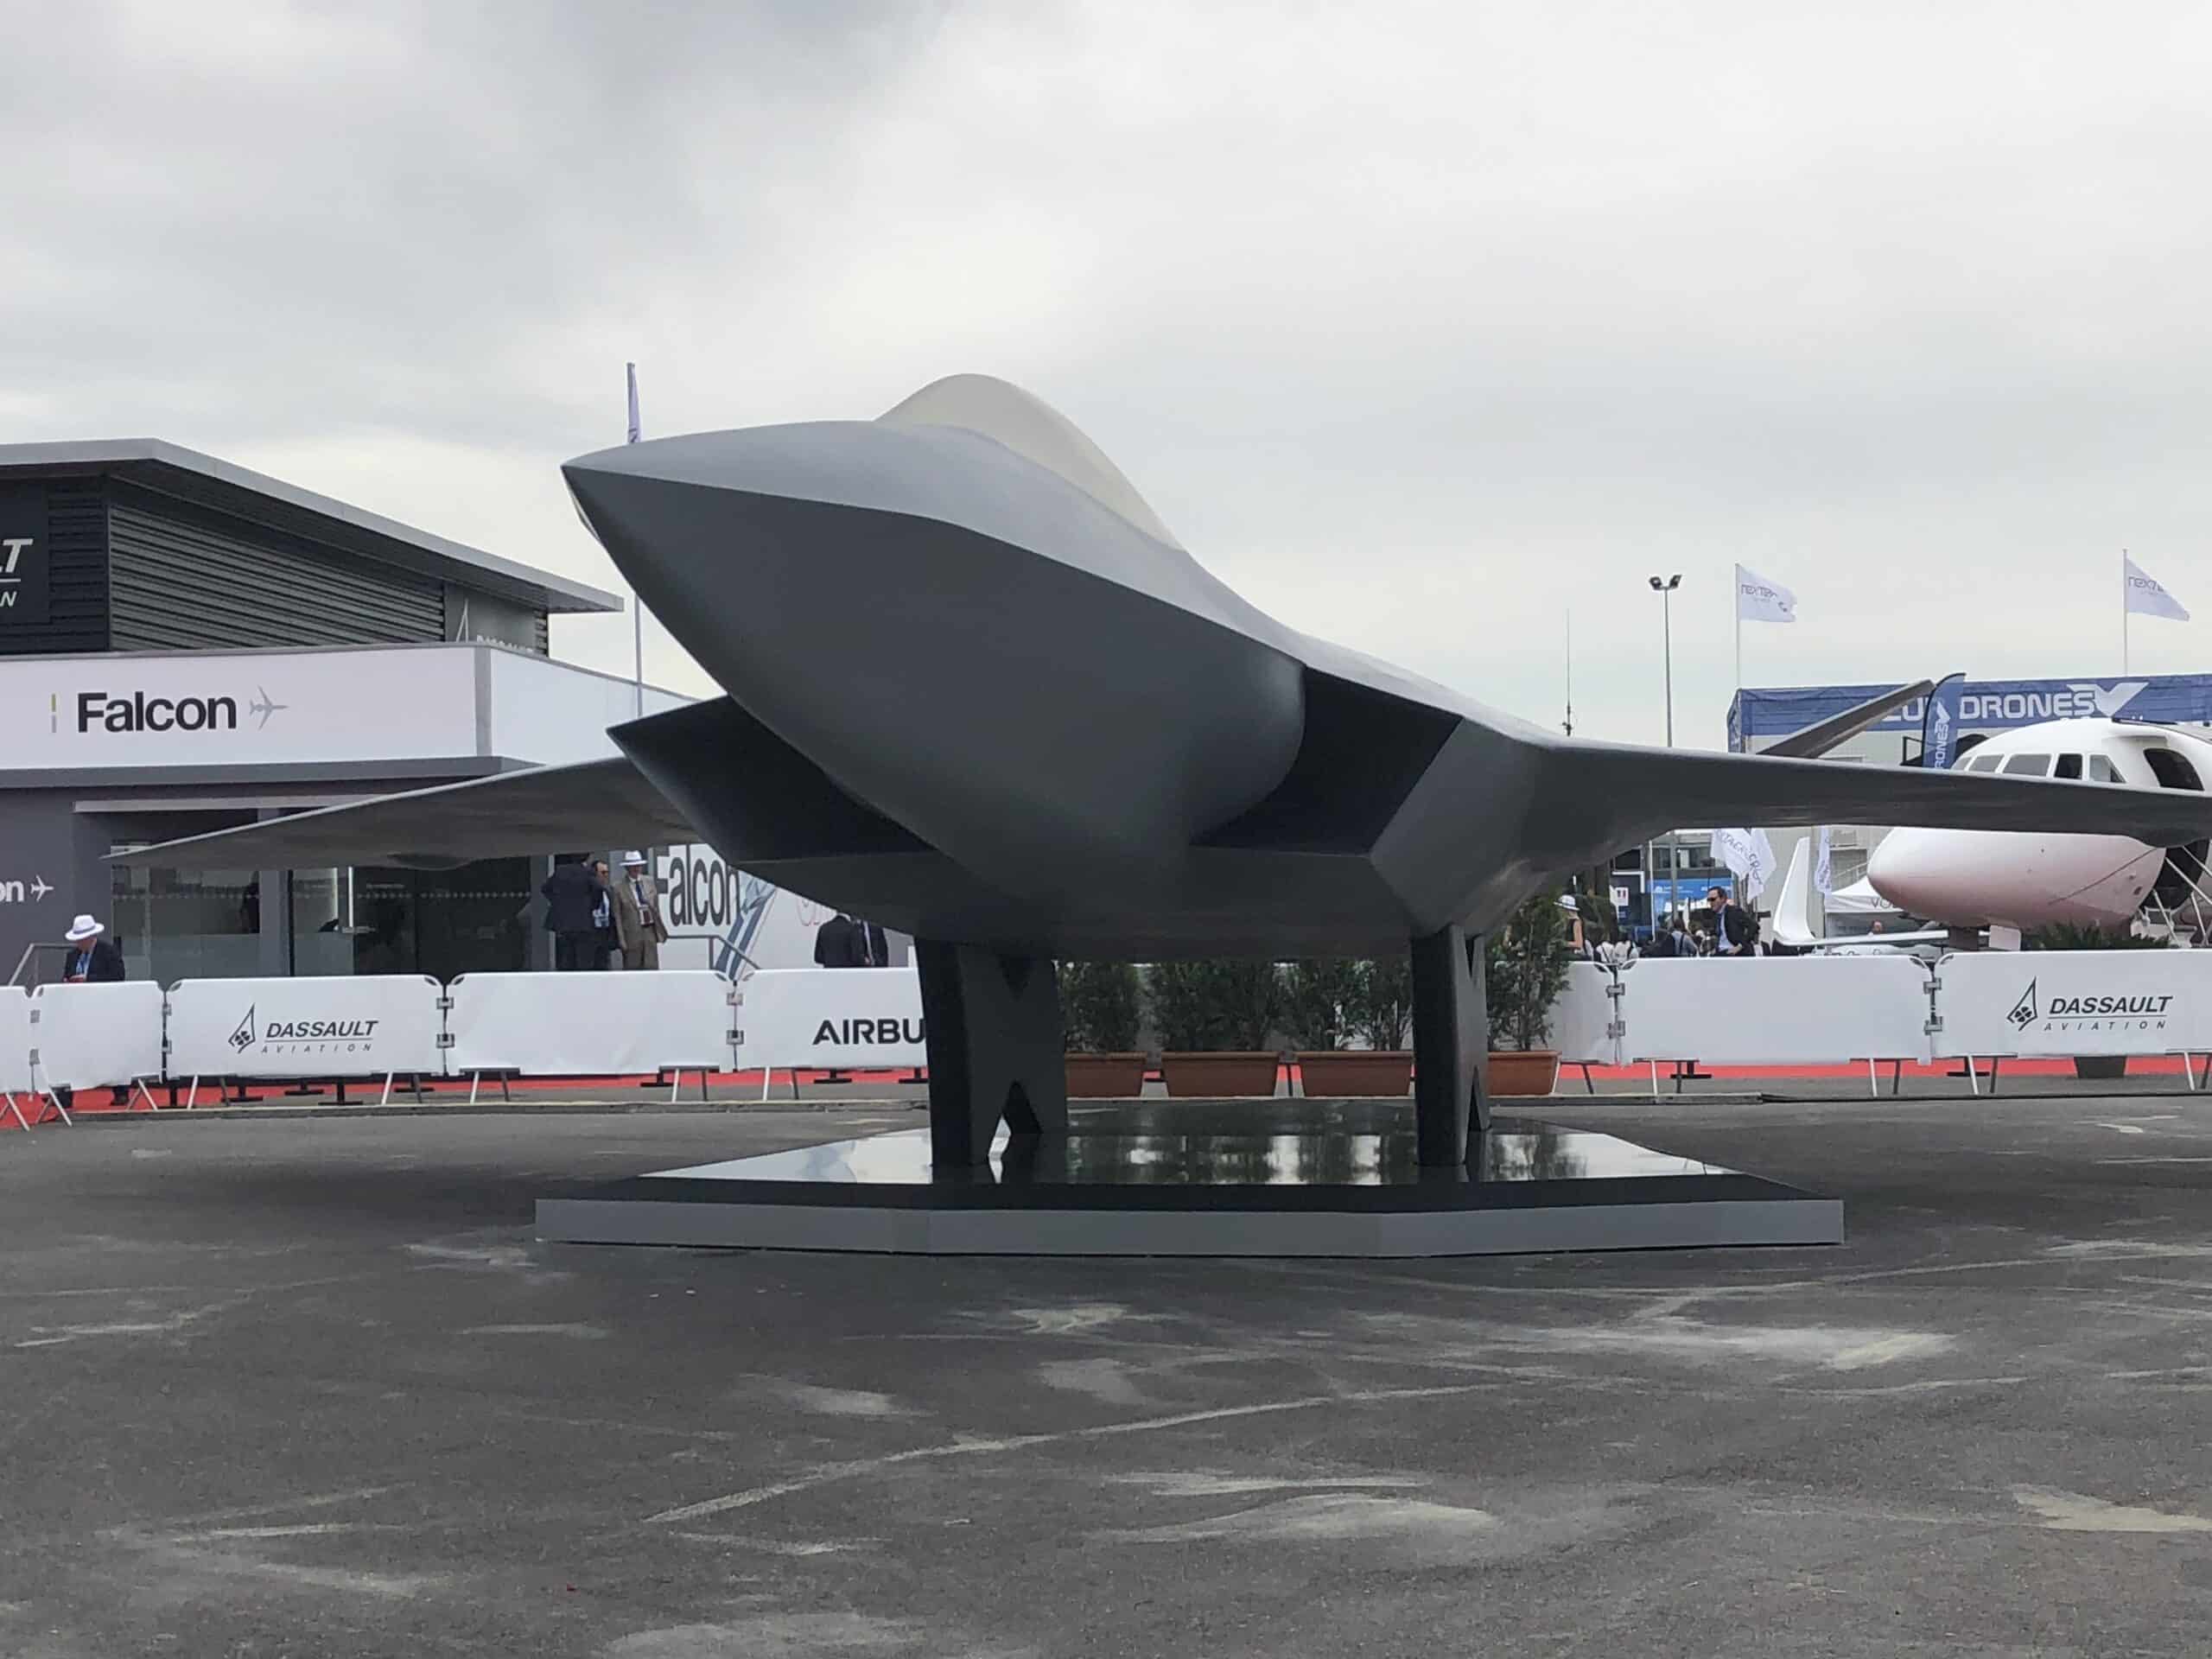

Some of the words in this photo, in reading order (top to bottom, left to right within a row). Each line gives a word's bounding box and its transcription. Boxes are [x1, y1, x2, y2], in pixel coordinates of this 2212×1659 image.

[77, 691, 238, 733] Falcon
[2049, 995, 2174, 1015] DASSAULT
[265, 1020, 378, 1039] DASSAULT
[811, 1018, 926, 1046] AIRBU
[2044, 1020, 2166, 1032] AVIATION
[260, 1043, 372, 1054] AVIATION
